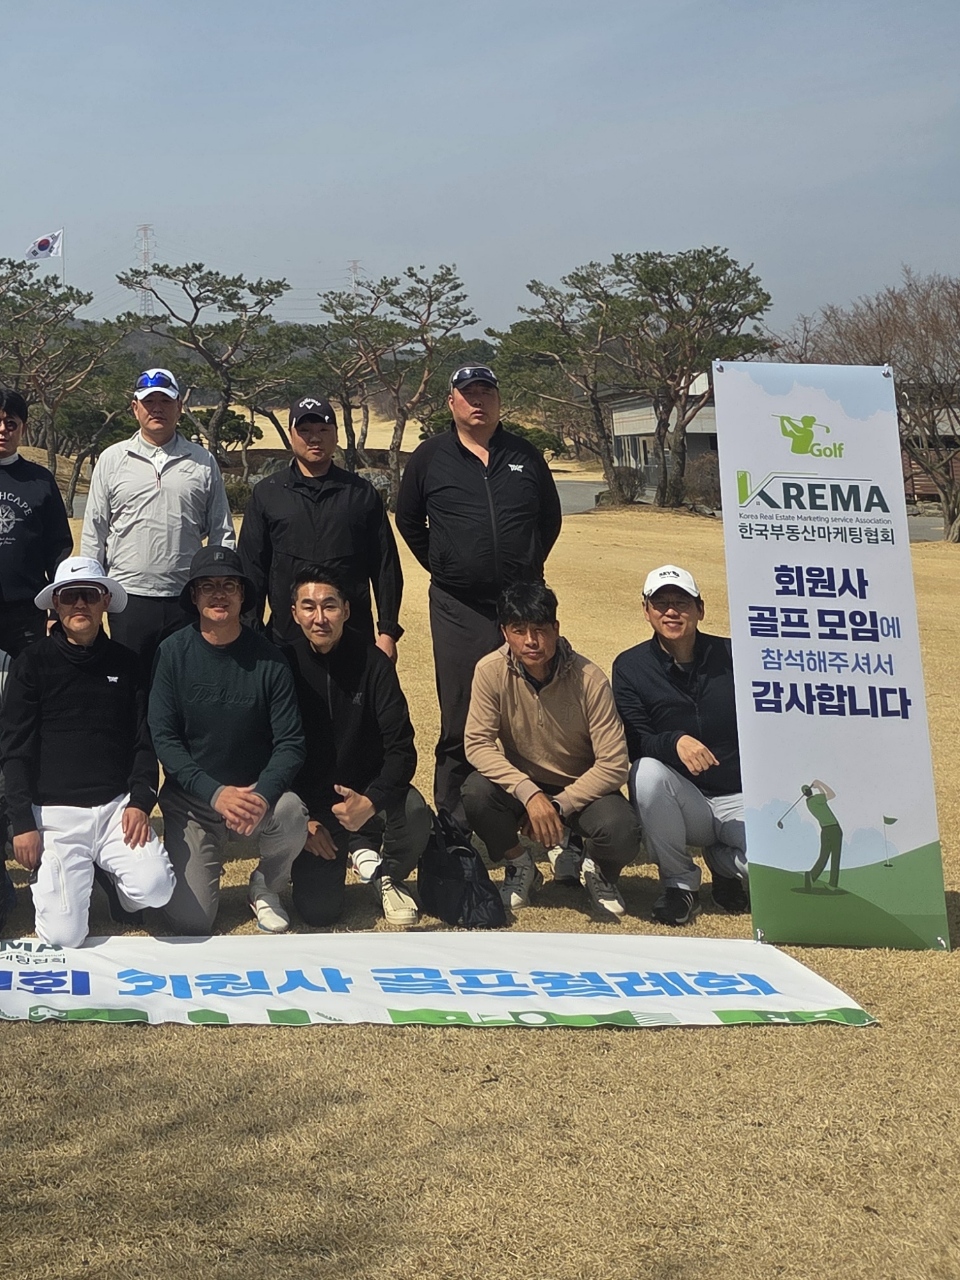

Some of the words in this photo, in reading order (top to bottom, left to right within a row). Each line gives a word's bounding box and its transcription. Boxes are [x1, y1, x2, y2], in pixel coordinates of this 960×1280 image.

[810, 443, 844, 458] Golf
[737, 471, 890, 513] KREMA
[738, 522, 895, 545] 한국부동산마케팅협회
[759, 513, 774, 521] Real
[796, 515, 830, 524] Marketing
[831, 516, 853, 524] service
[855, 517, 892, 525] Association
[774, 564, 869, 599] 회원사
[748, 605, 811, 639] 골프
[817, 609, 901, 642] 모임에
[761, 648, 894, 676] 참석해주셔서
[751, 681, 912, 719] 감사합니다
[370, 967, 784, 998] 골프월례회
